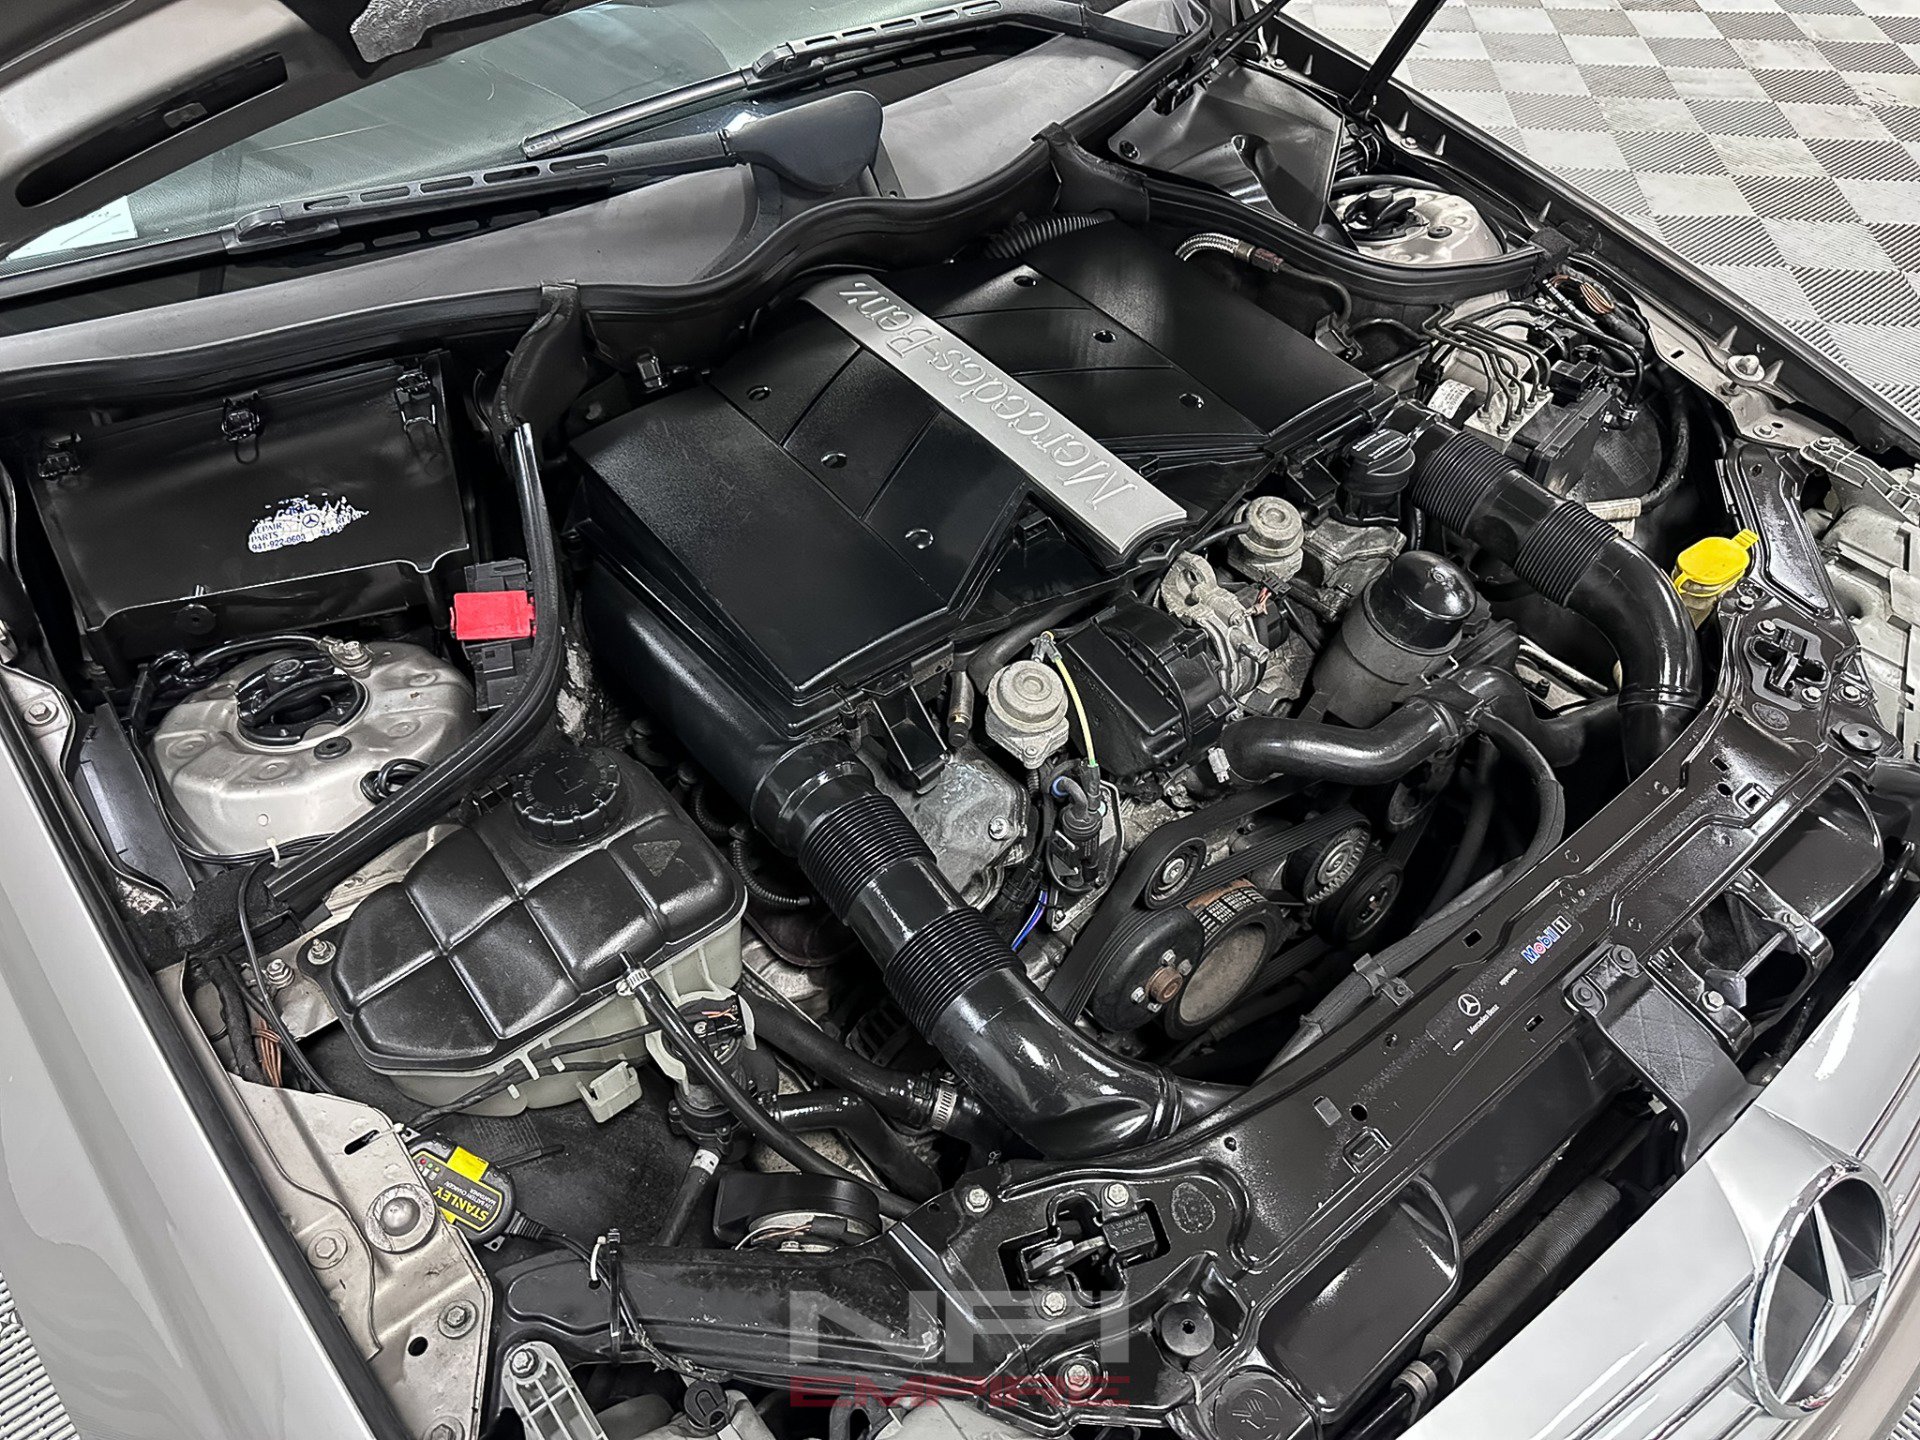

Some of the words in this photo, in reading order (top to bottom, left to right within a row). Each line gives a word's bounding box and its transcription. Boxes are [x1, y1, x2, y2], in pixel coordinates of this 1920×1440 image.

[839, 281, 1138, 510] Mercedes-Benz
[251, 531, 279, 543] PARTS
[1521, 925, 1560, 964] Mobil
[433, 1186, 489, 1222] STANLEY
